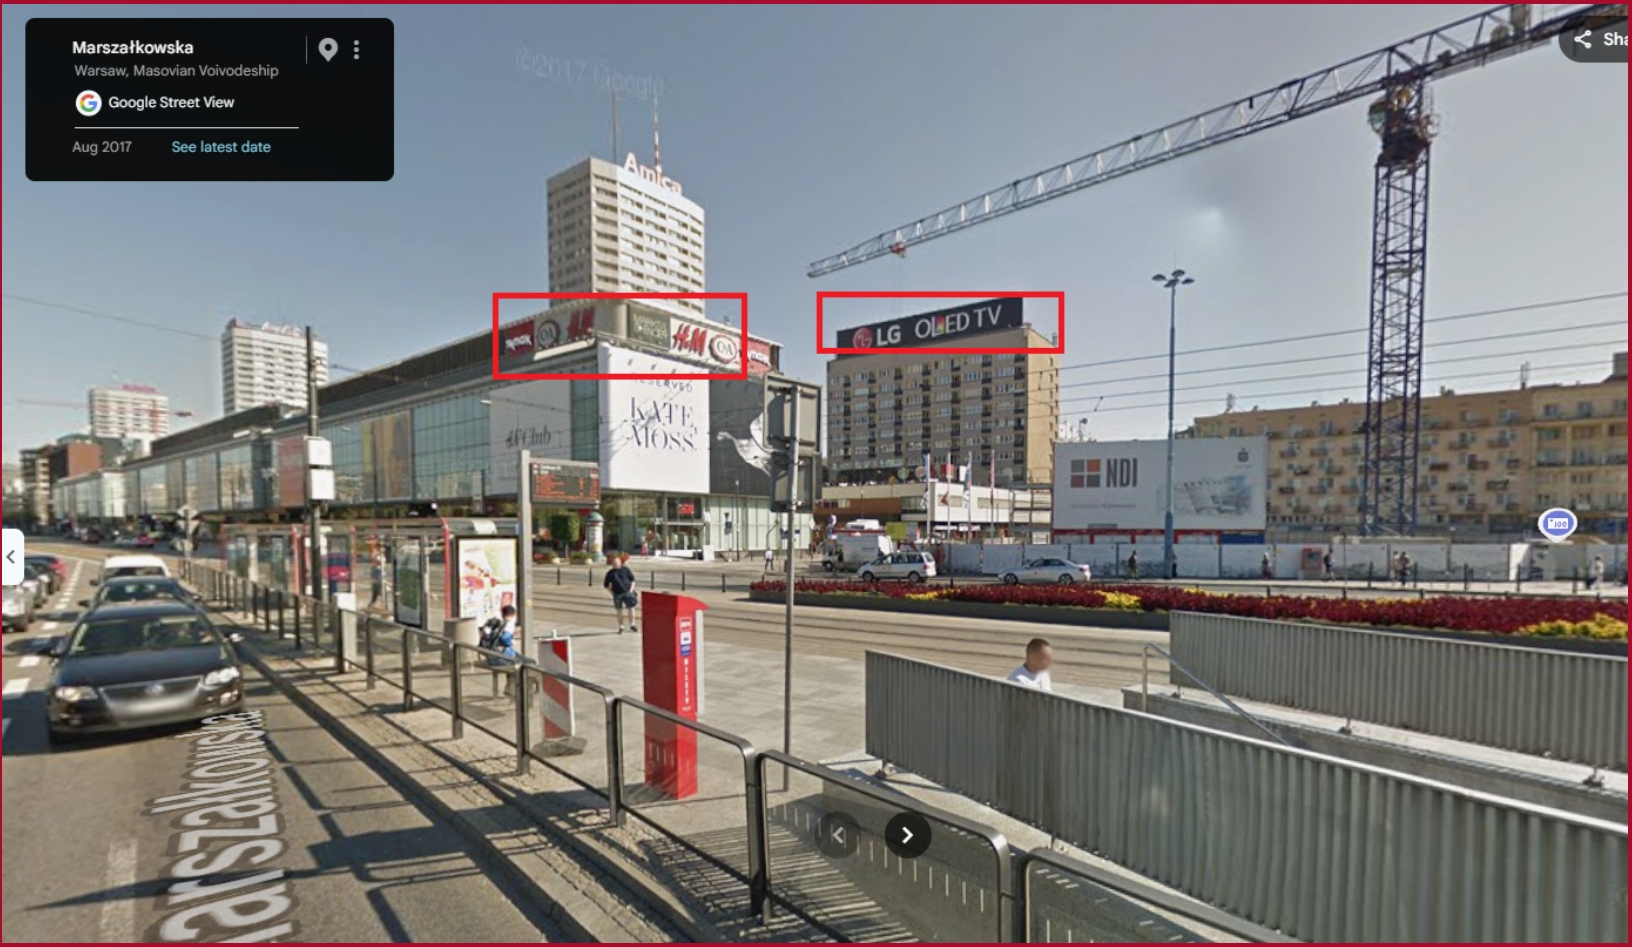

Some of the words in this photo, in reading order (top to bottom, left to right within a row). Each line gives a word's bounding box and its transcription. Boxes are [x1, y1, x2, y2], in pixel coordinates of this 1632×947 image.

[624, 152, 682, 194] Amica
[672, 322, 707, 355] H&M
[876, 325, 902, 346] LG
[915, 311, 970, 338] OLED
[974, 304, 1002, 328] TV
[1106, 458, 1138, 488] NDI
